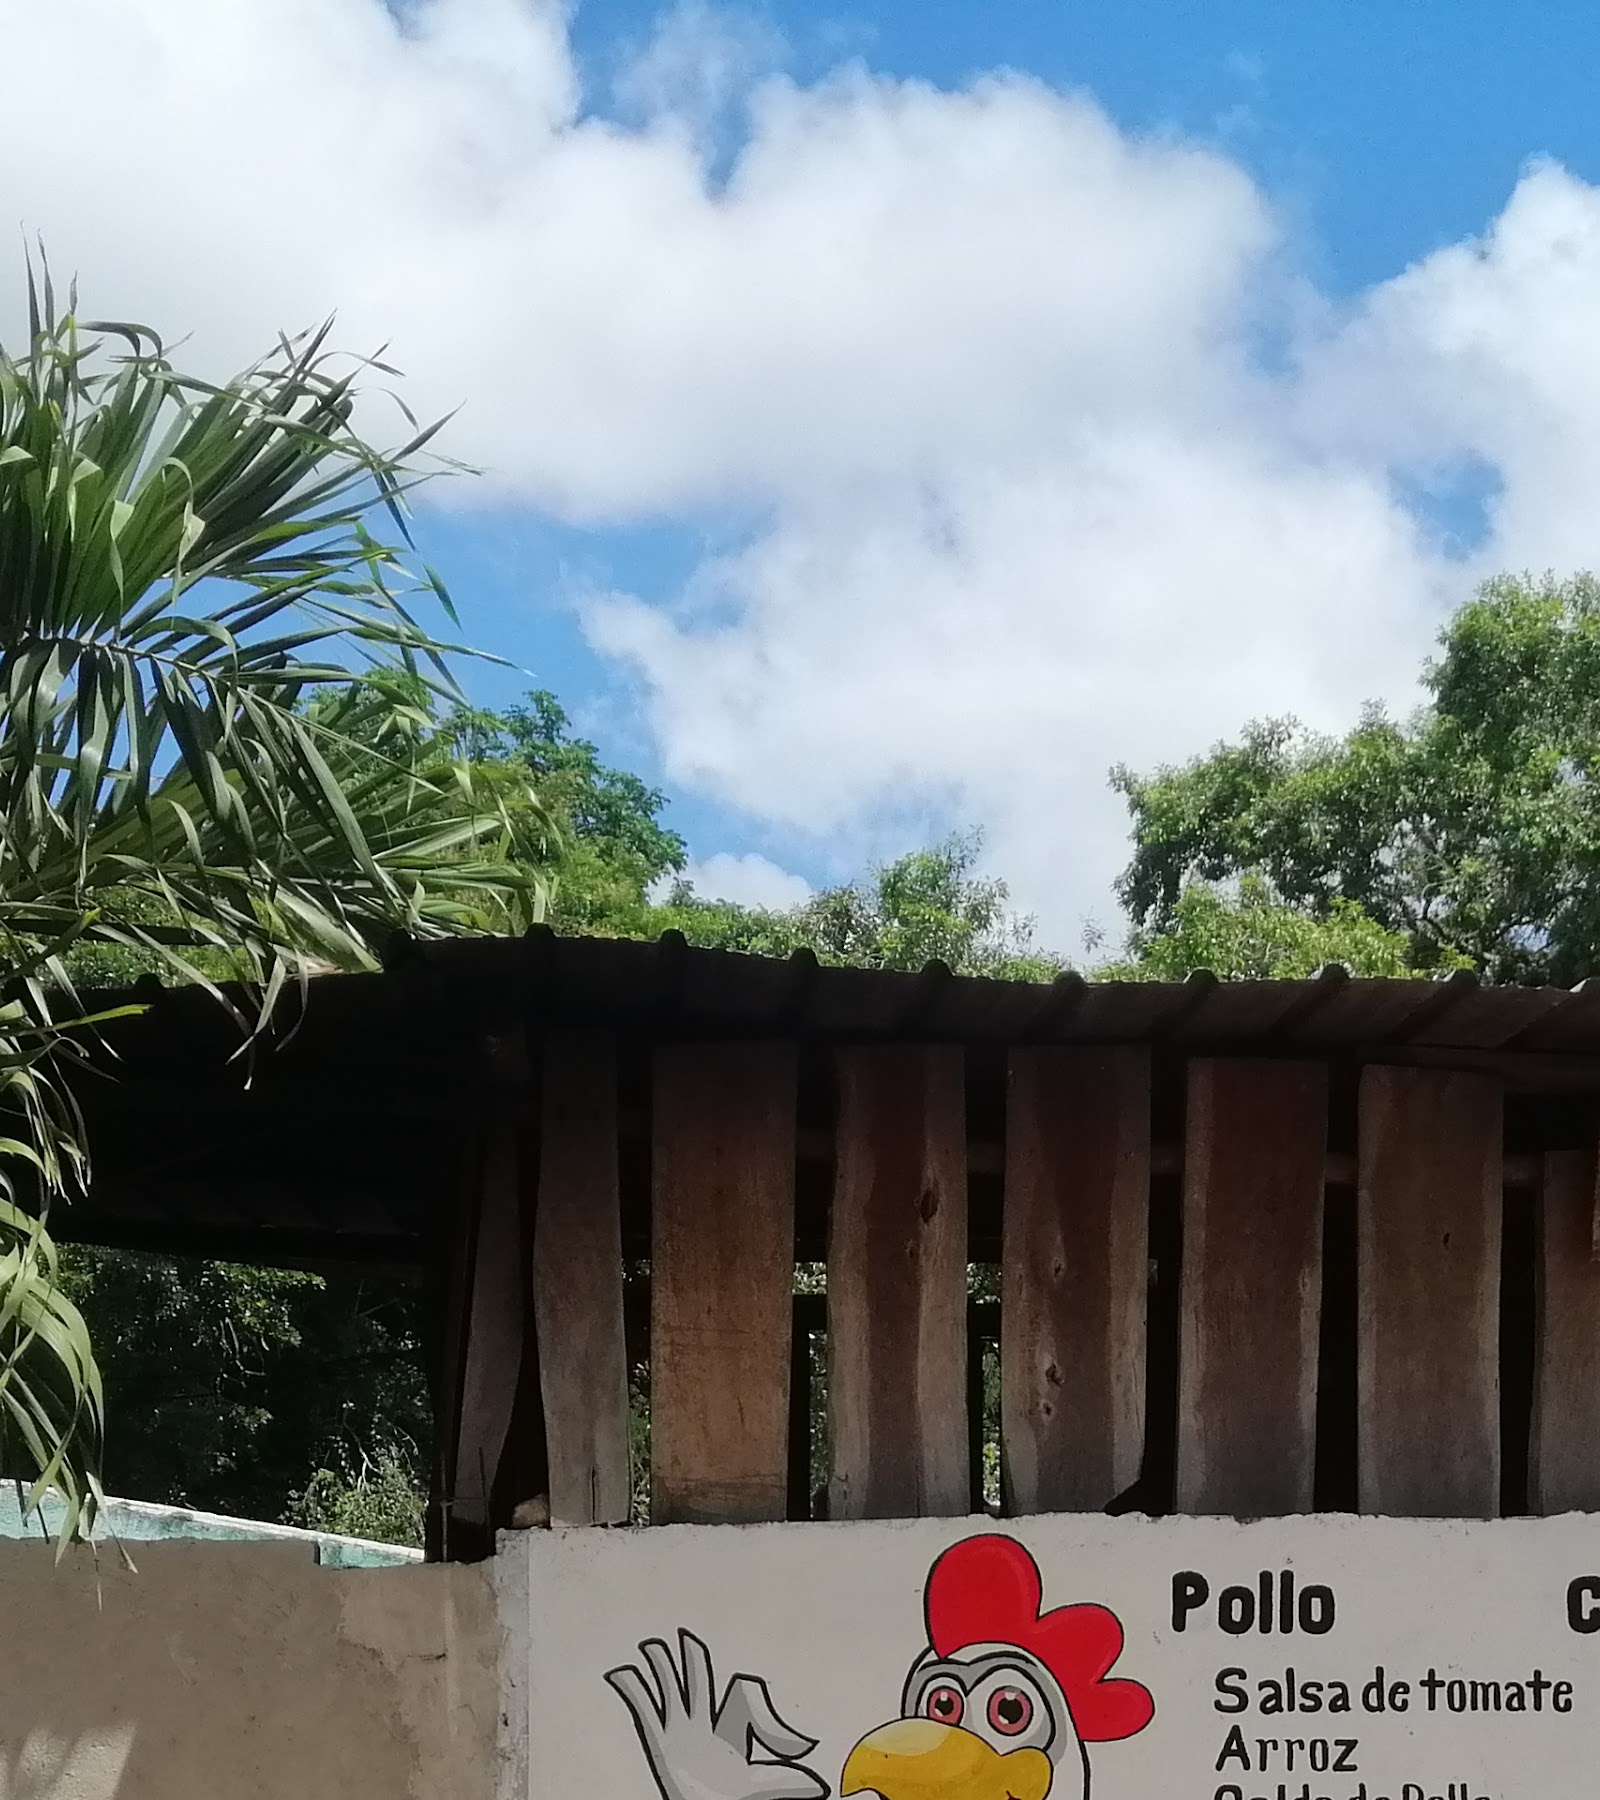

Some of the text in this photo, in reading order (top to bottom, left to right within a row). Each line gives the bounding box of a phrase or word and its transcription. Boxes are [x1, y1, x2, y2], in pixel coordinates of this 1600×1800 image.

[1172, 1569, 1335, 1635] Pollo
[1214, 1666, 1574, 1715] Salsa de tomate
[1215, 1725, 1359, 1772] Arroz
